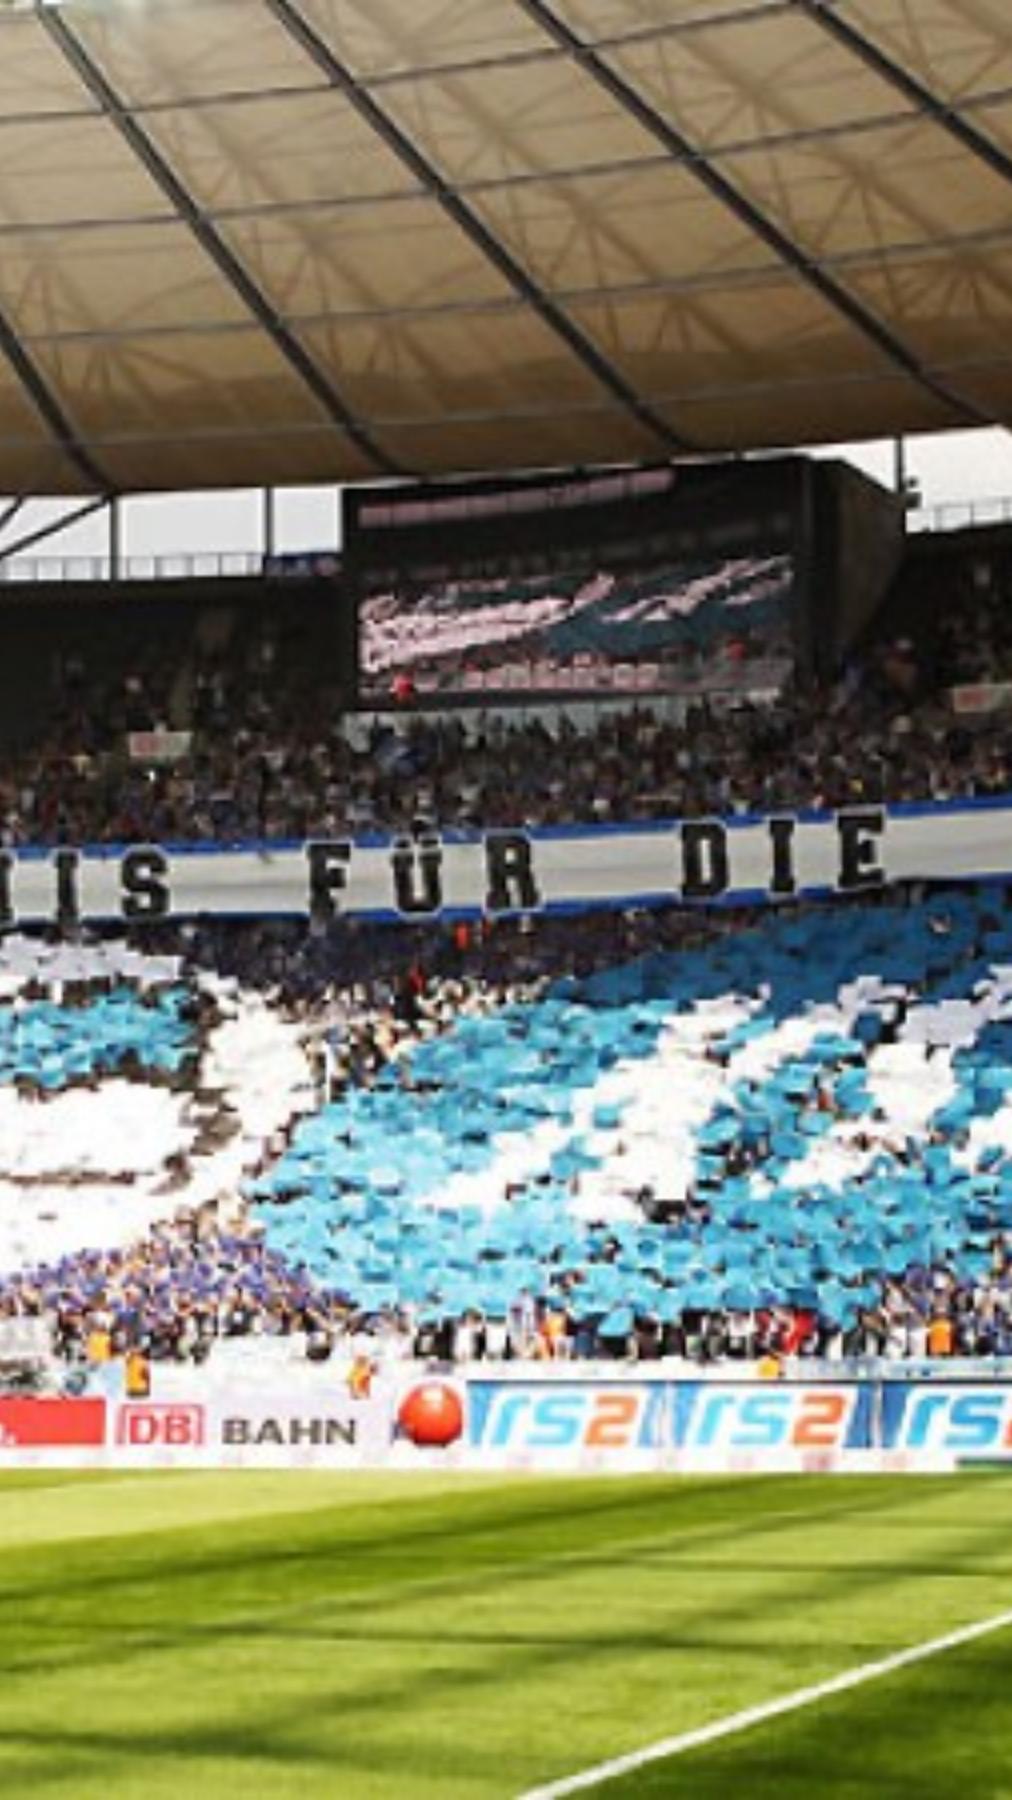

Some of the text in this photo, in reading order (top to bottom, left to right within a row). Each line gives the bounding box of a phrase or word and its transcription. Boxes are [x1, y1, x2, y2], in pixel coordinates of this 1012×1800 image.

[309, 835, 541, 918] FÜR
[682, 813, 885, 897] DIE
[130, 1411, 356, 1445] DB BAHN
[491, 1396, 637, 1446] rs2
[697, 1396, 843, 1446] rs2
[906, 1395, 1012, 1447] rs
